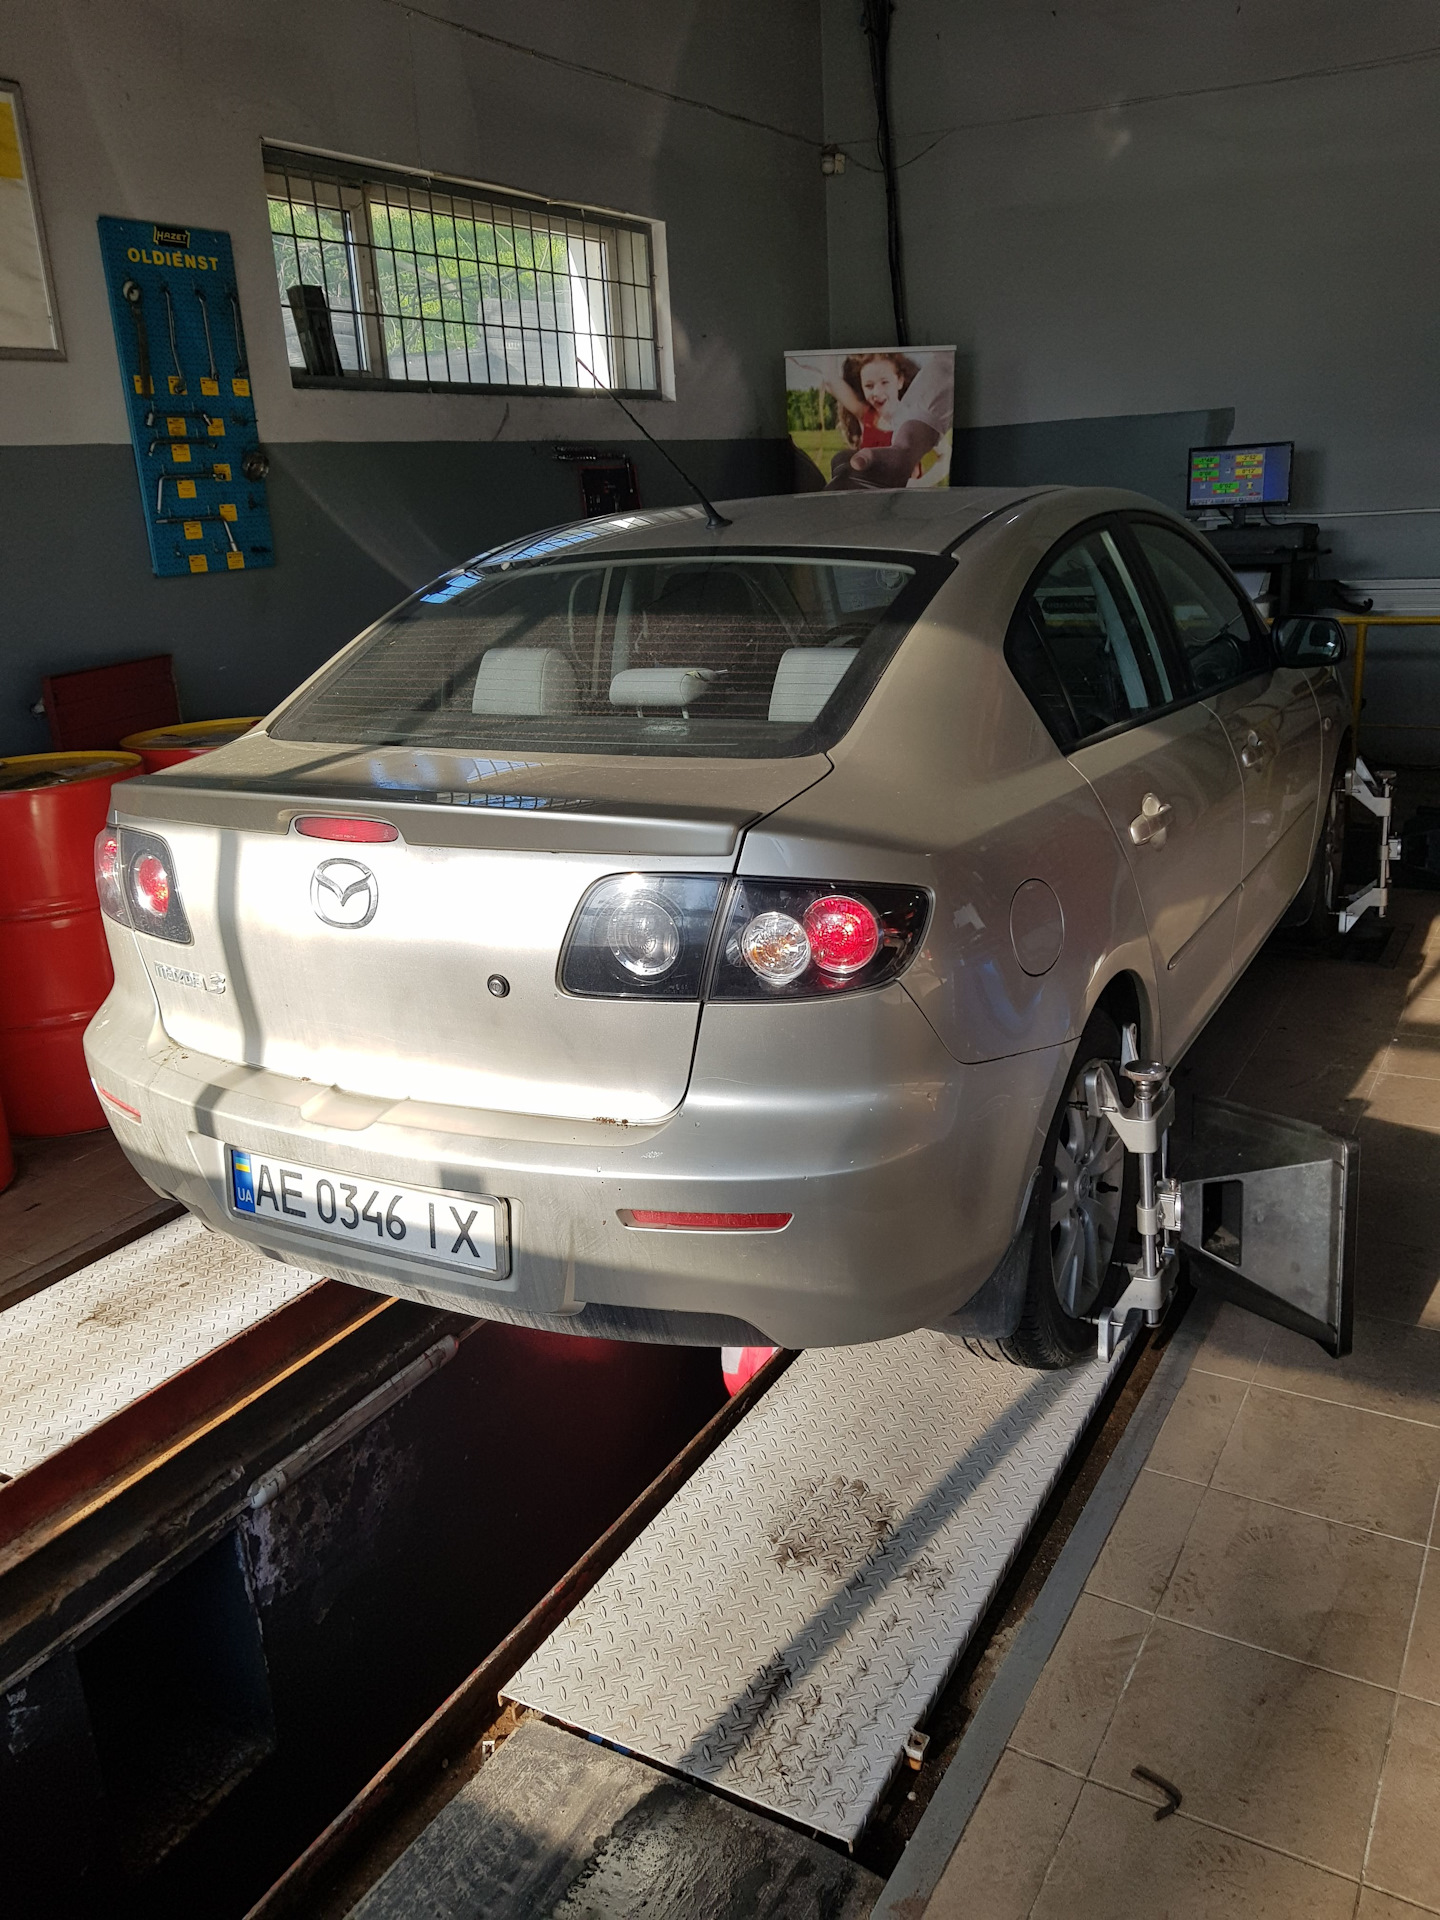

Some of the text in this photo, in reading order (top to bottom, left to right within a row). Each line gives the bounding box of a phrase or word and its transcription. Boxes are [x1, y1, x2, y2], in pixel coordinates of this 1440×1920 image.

[156, 230, 187, 242] HAZET
[127, 247, 219, 271] OLDIENST
[237, 1187, 254, 1204] UA
[256, 1164, 481, 1258] AE 0346 IX
